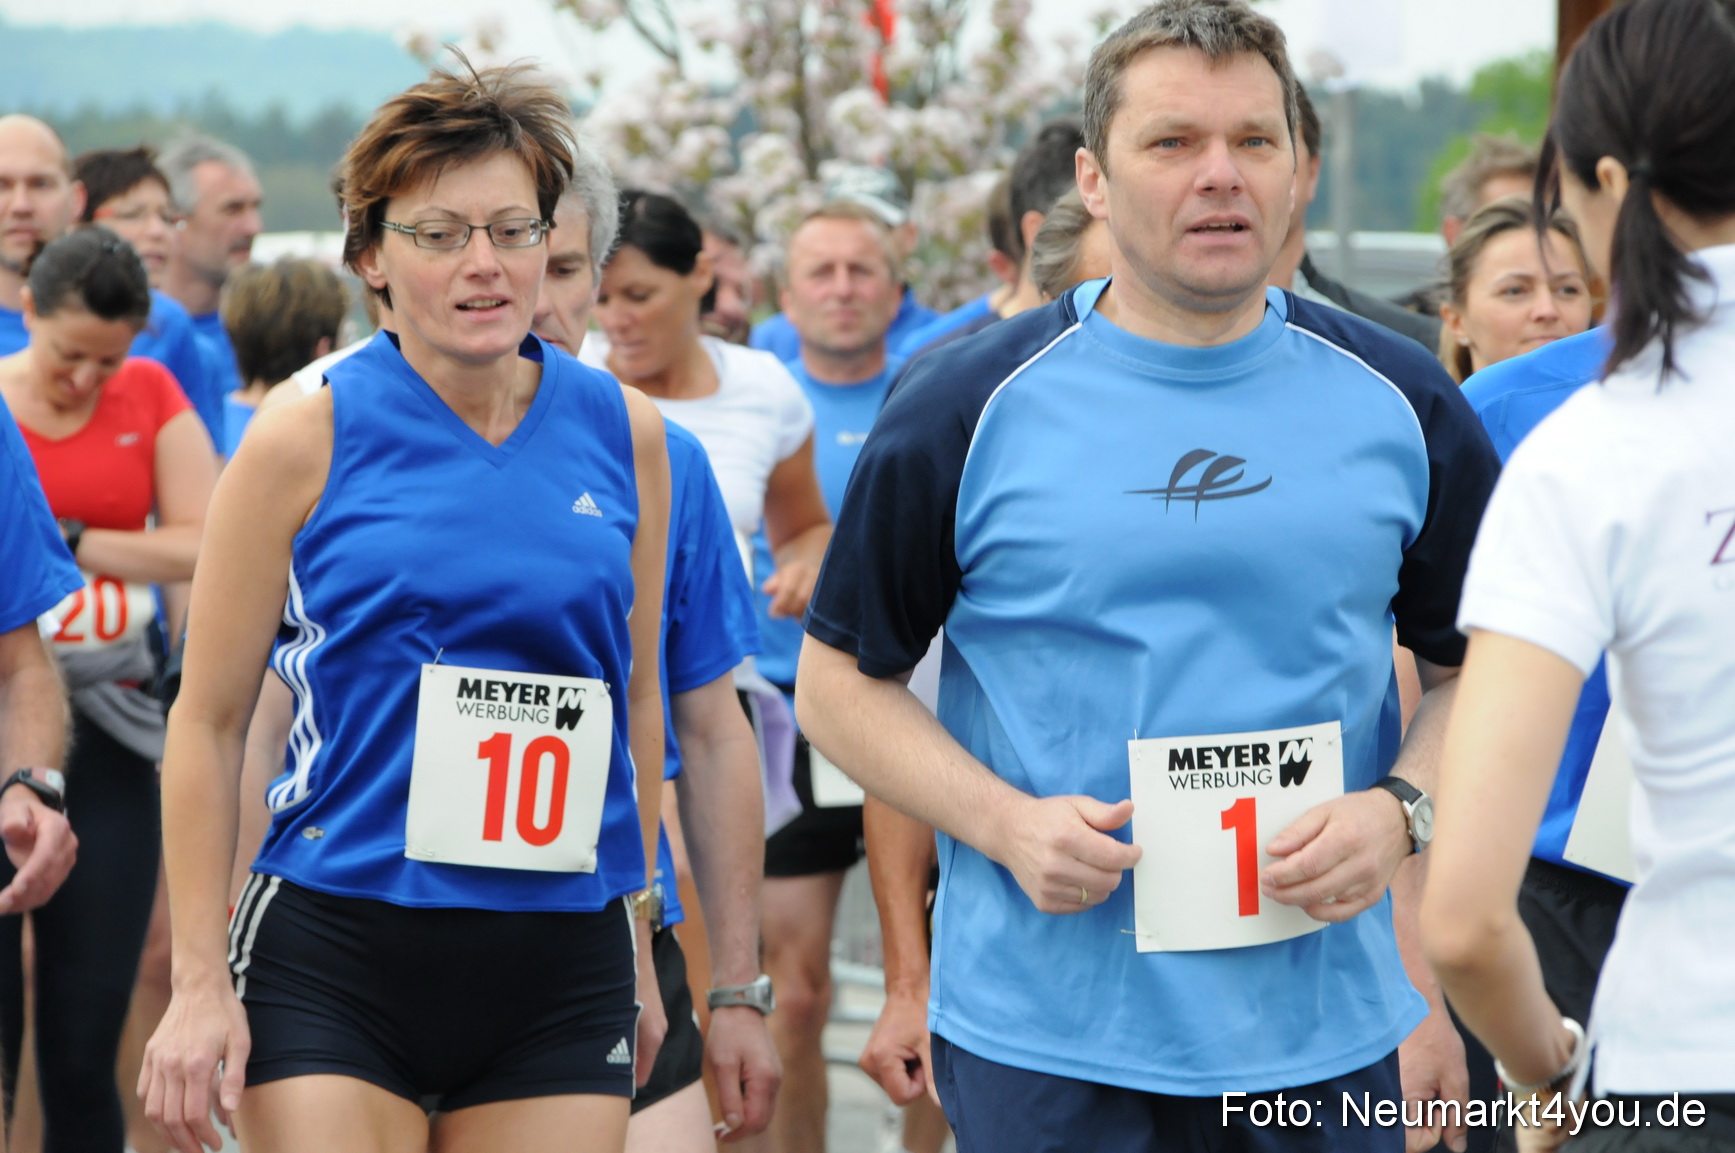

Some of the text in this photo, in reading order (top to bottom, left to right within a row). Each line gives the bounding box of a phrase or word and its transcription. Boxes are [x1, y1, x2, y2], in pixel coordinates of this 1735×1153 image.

[53, 575, 128, 642] 20
[457, 677, 550, 707] MEYER
[456, 701, 550, 724] WERBUNG
[1168, 743, 1272, 772] MEYER
[477, 732, 570, 847] 10
[1168, 768, 1273, 790] WERBUNG
[1221, 797, 1259, 917] 1
